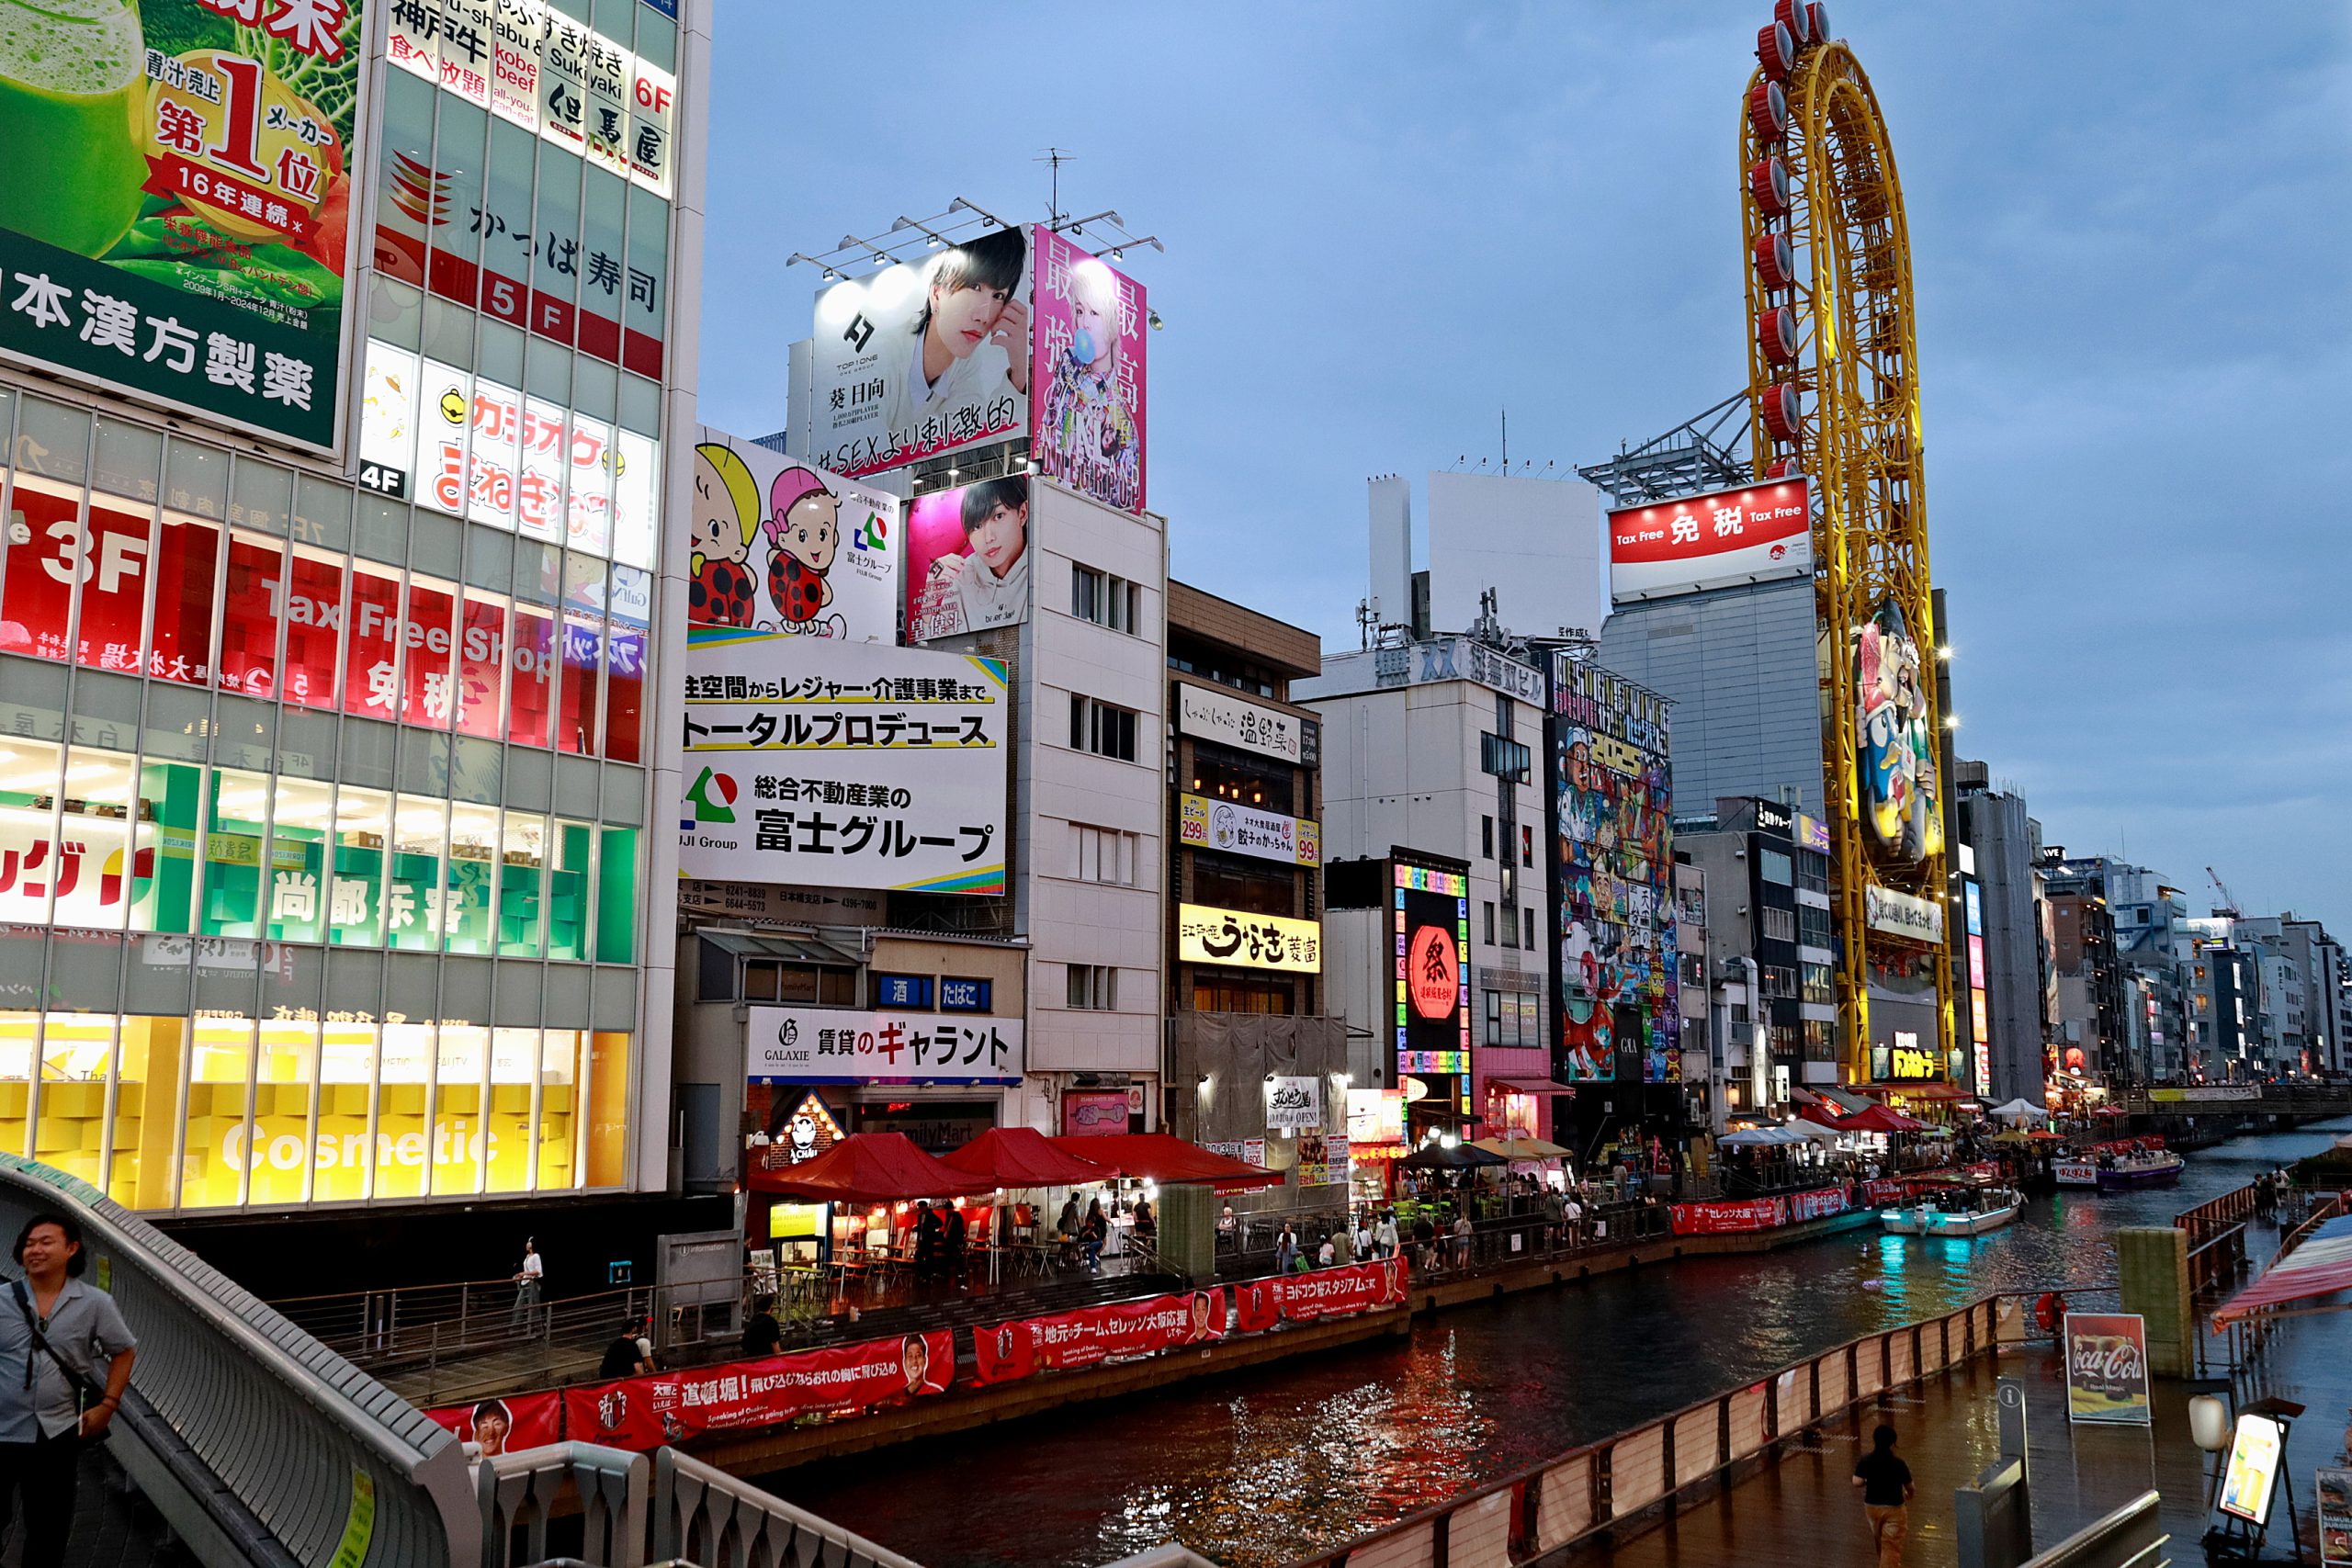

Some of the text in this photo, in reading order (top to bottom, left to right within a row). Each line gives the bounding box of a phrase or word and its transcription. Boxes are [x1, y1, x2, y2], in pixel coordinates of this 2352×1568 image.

[388, 0, 488, 64] 神戸牛
[145, 49, 221, 103] 青汁売上
[388, 34, 486, 102] 食べ放題
[495, 42, 537, 76] kobe
[495, 62, 535, 94] beef
[550, 48, 622, 100] Sukiyaki
[635, 77, 672, 115] 6F
[266, 105, 333, 145] メーカー
[469, 204, 657, 313] かっぱ寿司
[0, 266, 313, 412] 本漢方製薬
[473, 394, 603, 468] カラオケ
[361, 466, 399, 492] 4F
[432, 439, 626, 545] まねきねこ
[1670, 506, 1743, 545] 免税
[1750, 505, 1802, 523] Tax Free
[41, 520, 147, 593] 3F
[1616, 529, 1664, 546] Tax Free
[847, 551, 892, 574] 富士グループ
[261, 578, 552, 683] Tax Free Shop
[366, 660, 464, 722] 免税
[684, 711, 989, 748] トータルプロデュース
[1240, 711, 1287, 752] 温野菜
[1591, 731, 1641, 777] 2025
[753, 774, 911, 810] 総合不動産業の
[699, 837, 738, 852] Group
[754, 808, 994, 863] 富士グループ
[1238, 828, 1294, 852] 餃子のかっちゃん
[2043, 848, 2060, 858] AVE
[1202, 915, 1285, 963] うなぎ
[1423, 933, 1451, 985] 祭
[893, 979, 976, 1006] 酒 たばこ
[764, 1049, 809, 1061] GALAXIE
[818, 1021, 1009, 1066] 賃貸のギャラント
[1295, 1111, 1317, 1123] OPEN!
[221, 1122, 499, 1171] Cosmetic
[691, 1244, 725, 1253] information
[2073, 1343, 2143, 1379] Coca-Cola
[707, 1411, 737, 1423] Speaking
[738, 1409, 745, 1417] of
[764, 1410, 784, 1420] going
